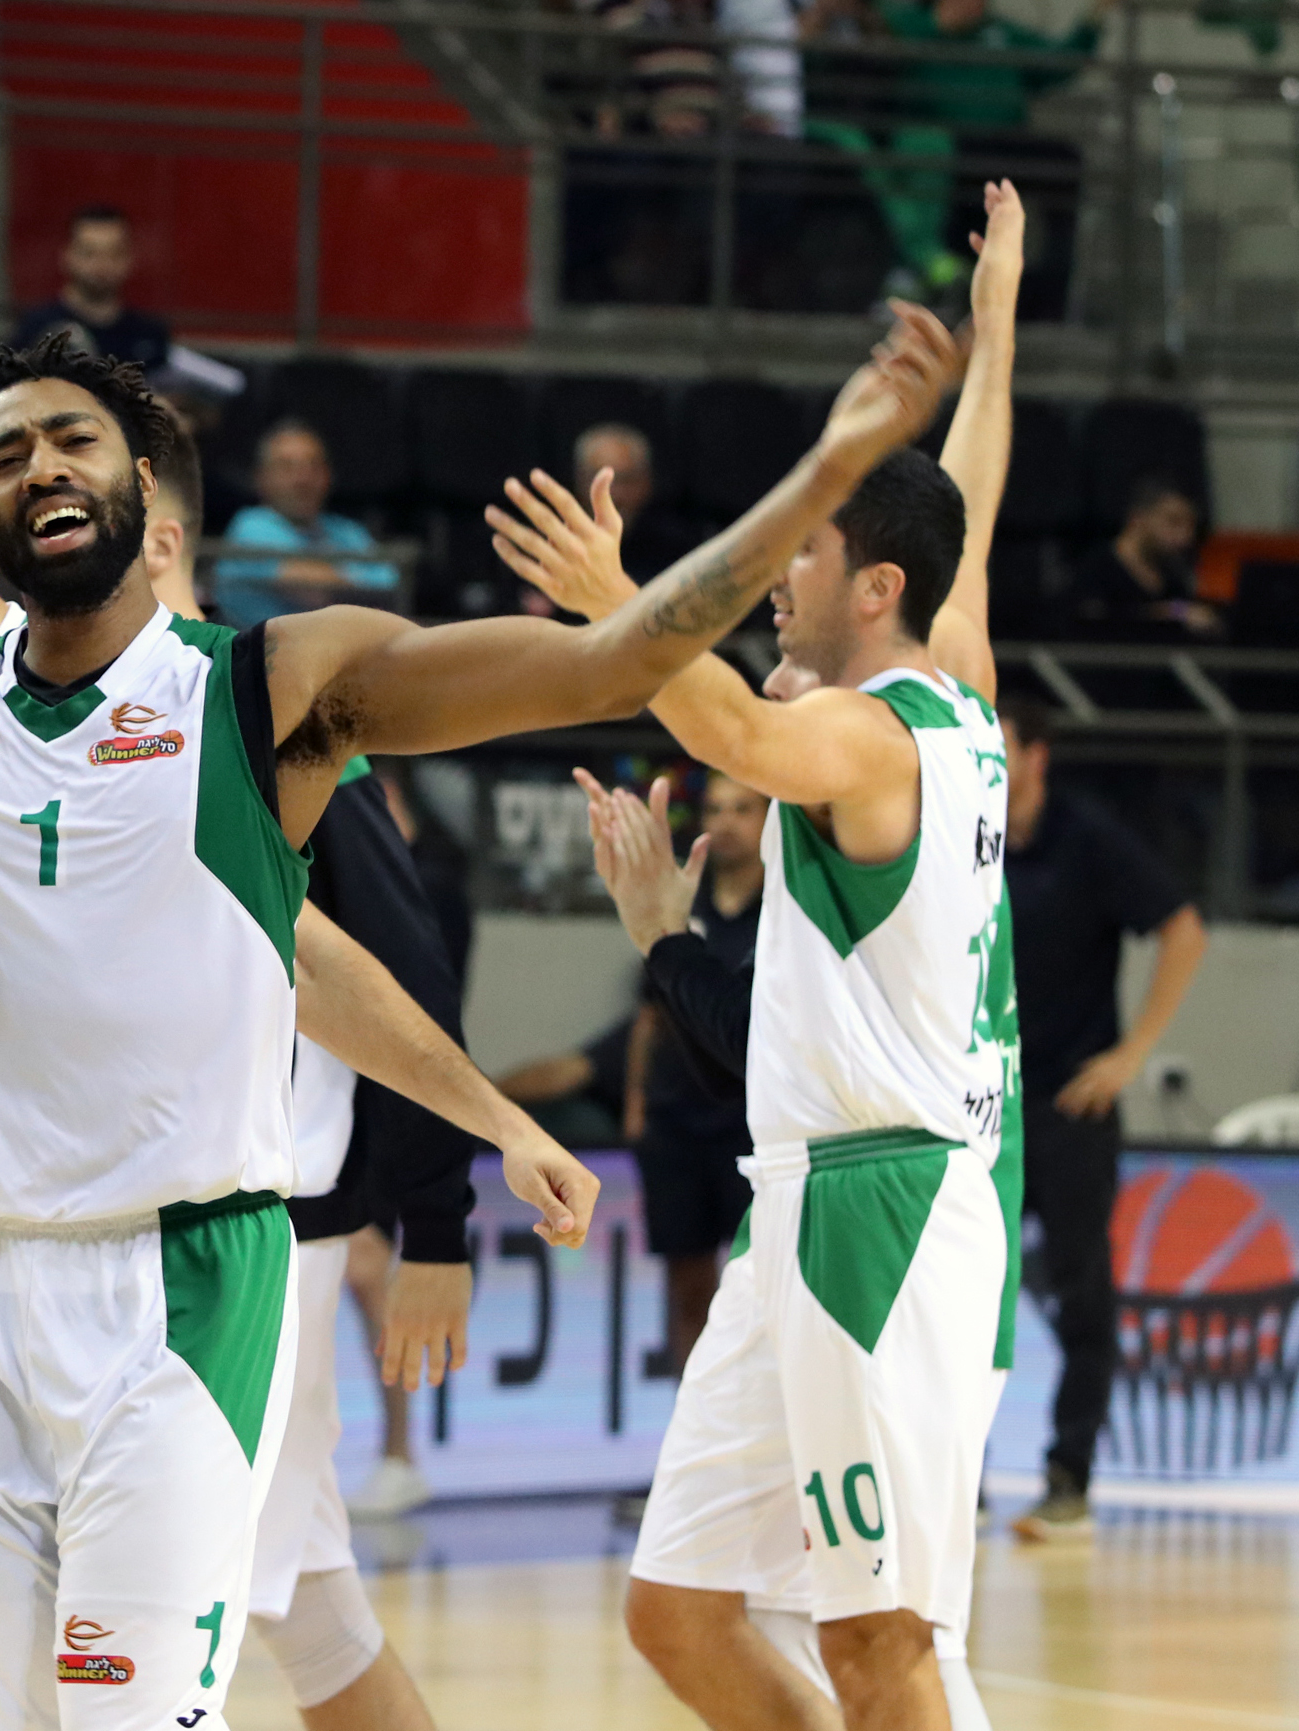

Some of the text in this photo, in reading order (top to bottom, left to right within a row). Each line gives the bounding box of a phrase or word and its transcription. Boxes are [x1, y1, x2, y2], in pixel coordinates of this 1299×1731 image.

[96, 744, 160, 763] Winner
[19, 799, 62, 886] 1
[804, 1462, 886, 1548] 10
[194, 1601, 225, 1689] 1
